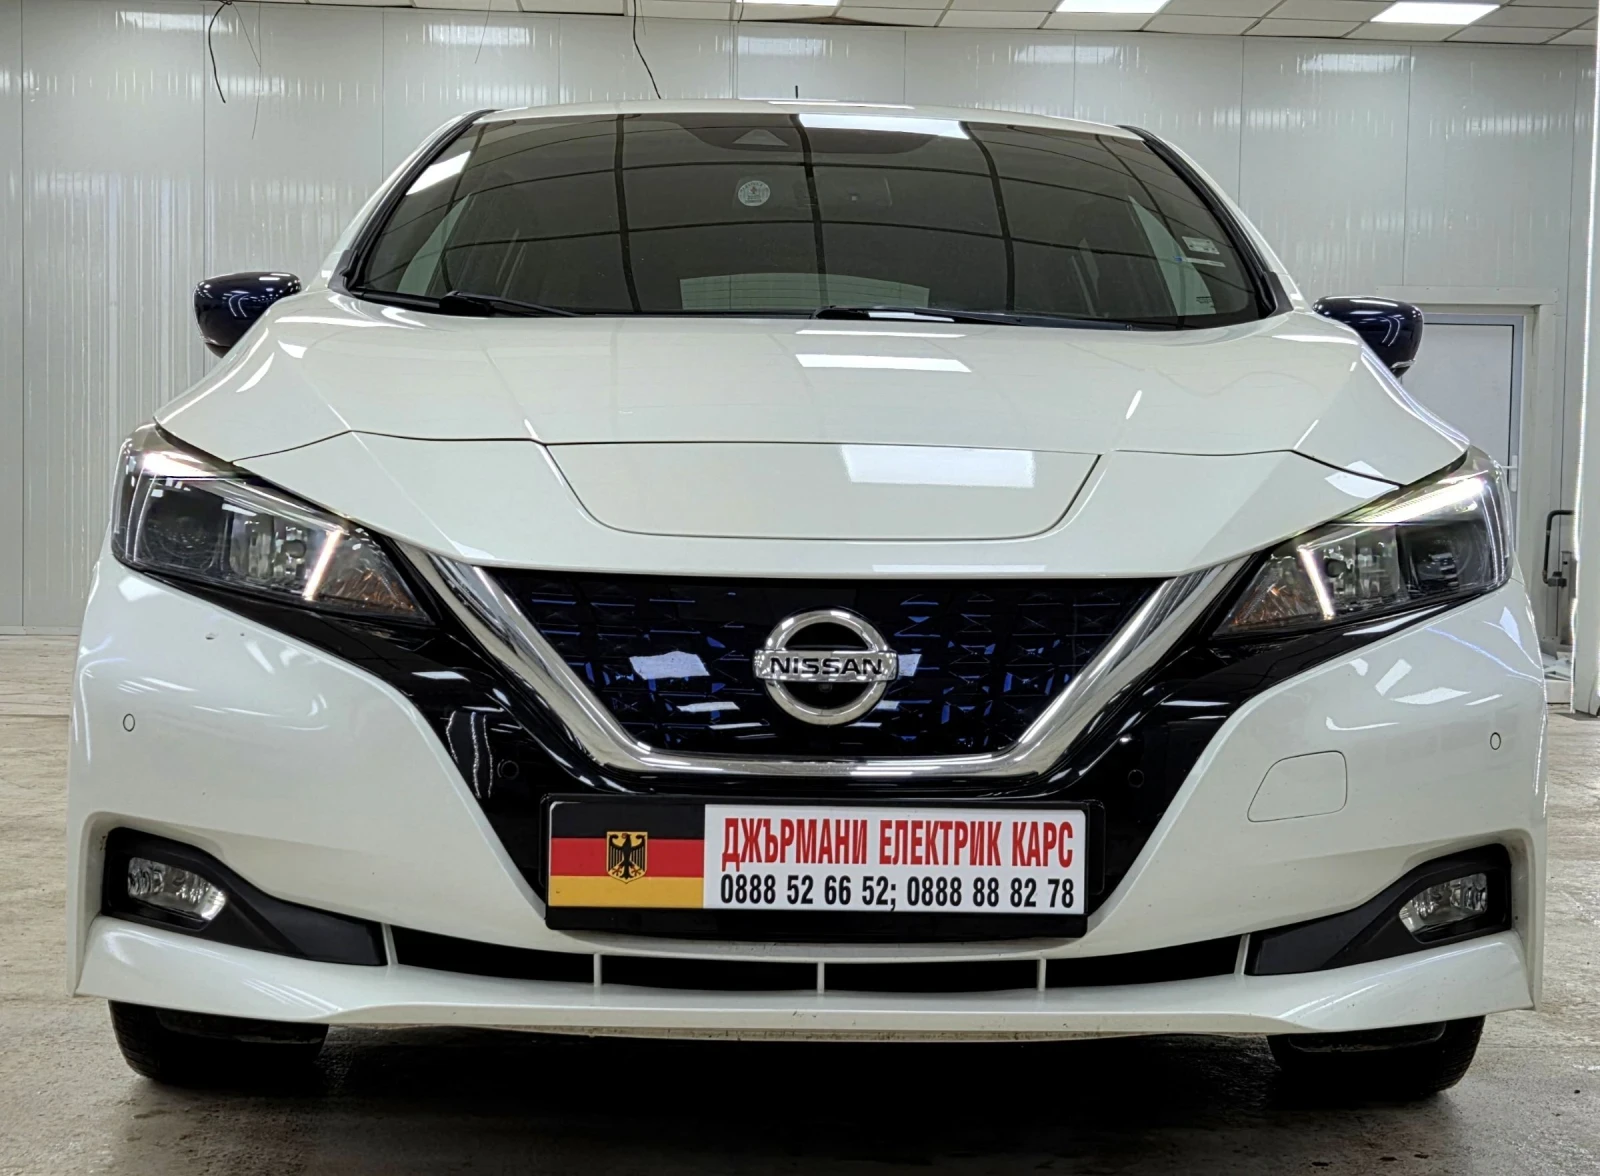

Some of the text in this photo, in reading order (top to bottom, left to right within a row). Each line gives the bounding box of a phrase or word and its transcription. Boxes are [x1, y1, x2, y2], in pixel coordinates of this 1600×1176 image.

[770, 657, 883, 675] NISSAN
[721, 817, 1074, 870] ДЖЪРМАНИ ЕЛЕКТРИК КАРС
[720, 873, 1074, 911] 0888 52 66 52; 0888 88 82 78
